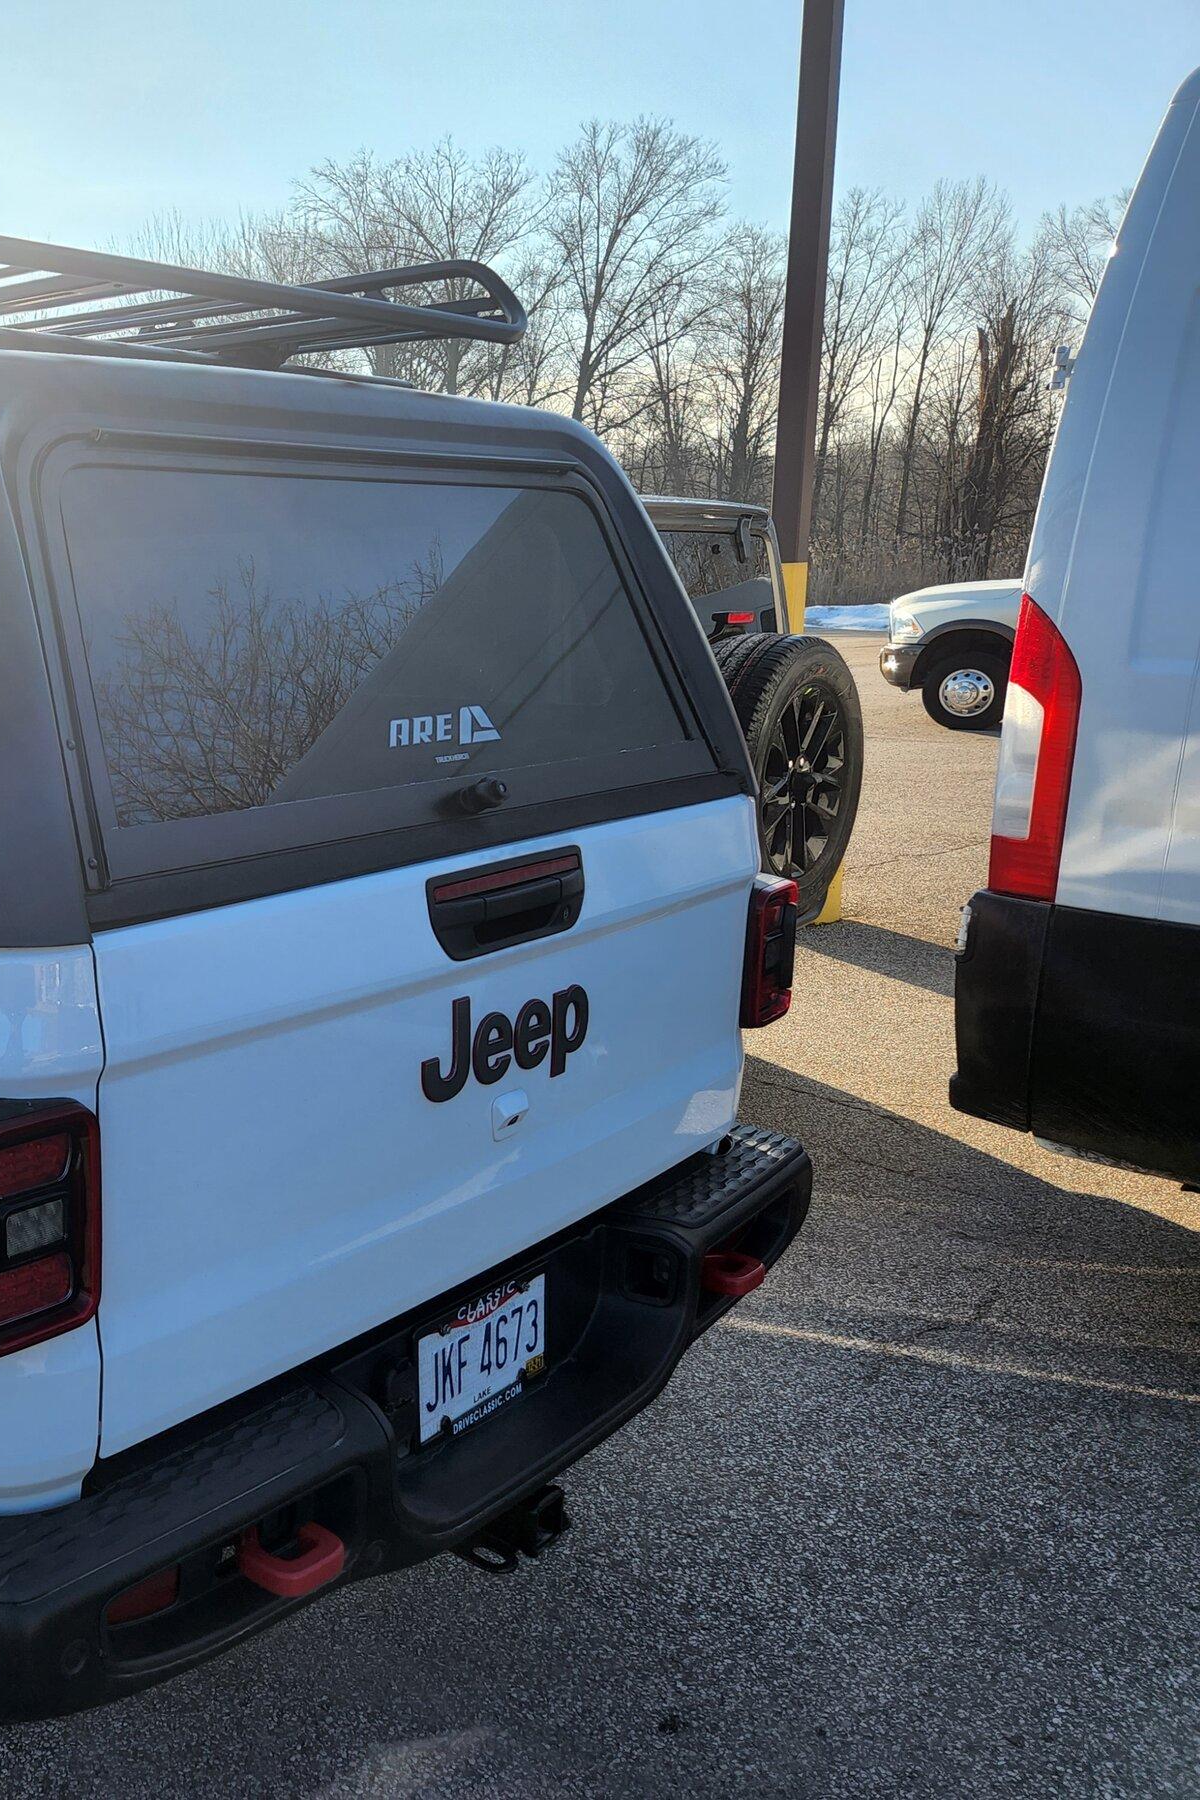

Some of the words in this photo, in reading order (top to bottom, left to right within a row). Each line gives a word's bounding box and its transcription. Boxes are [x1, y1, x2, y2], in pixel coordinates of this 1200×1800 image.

[389, 714, 452, 748] ARE
[421, 984, 588, 1103] Jeep
[457, 1280, 516, 1320] CLASSIC
[426, 1333, 470, 1412] JKF
[480, 1299, 538, 1377] 4673
[452, 1382, 522, 1435] DRIVECLASSIC.COM
[473, 1386, 491, 1403] LAKE
